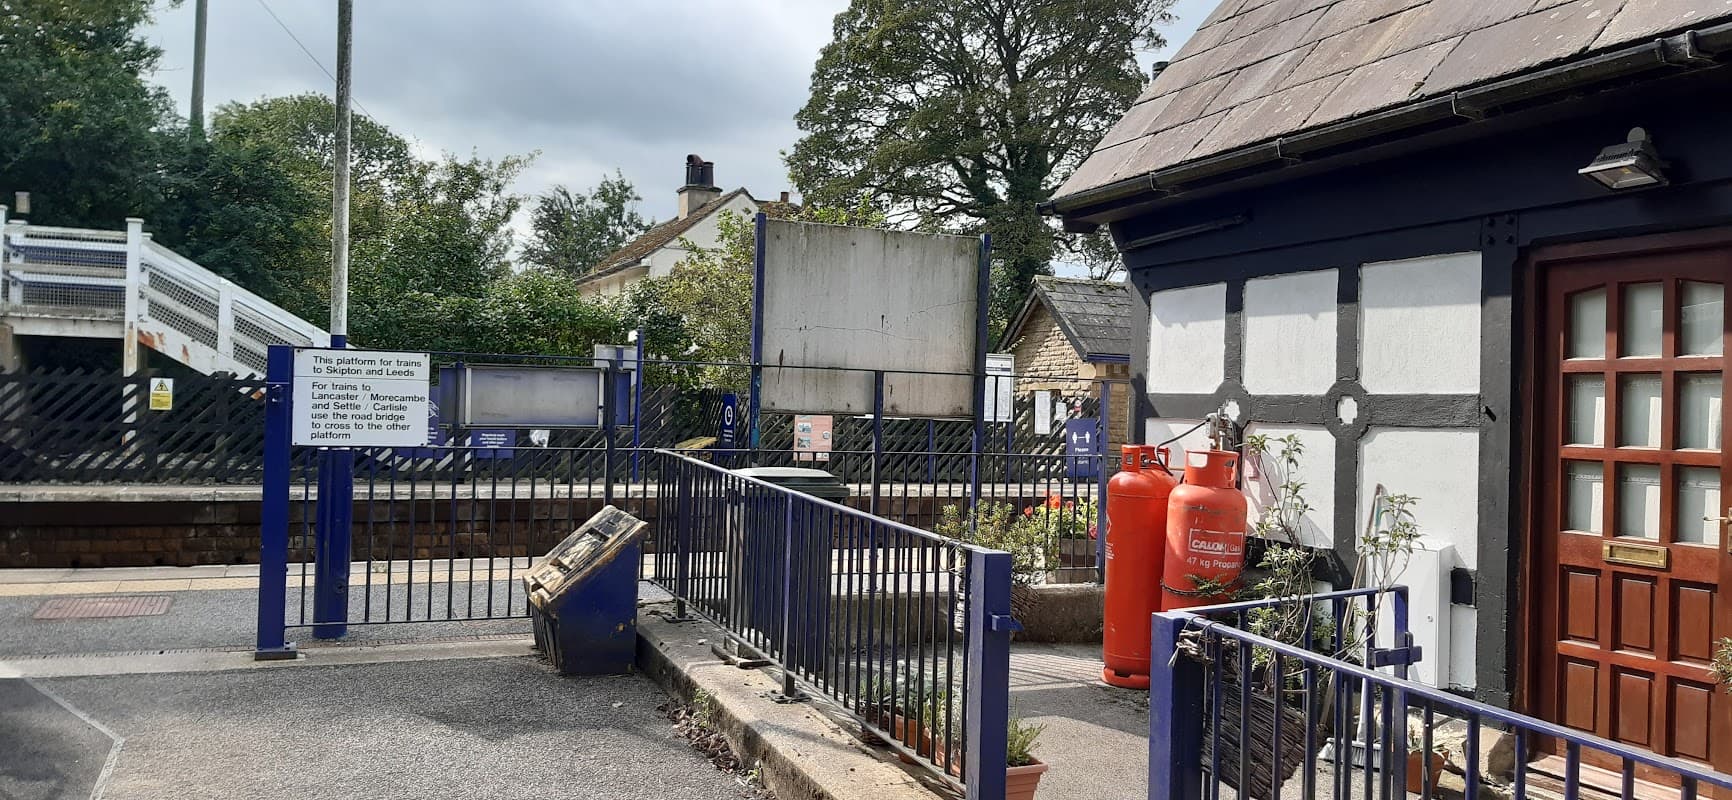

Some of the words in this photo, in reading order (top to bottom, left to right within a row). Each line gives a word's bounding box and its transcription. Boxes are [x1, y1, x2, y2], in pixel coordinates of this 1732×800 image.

[313, 356, 333, 364] This
[336, 357, 376, 366] platform
[380, 358, 392, 366] for
[326, 366, 362, 376] Skipton
[366, 368, 383, 376] and
[386, 368, 415, 376] Leeds
[312, 382, 328, 390] For
[332, 382, 358, 391] trains
[312, 392, 359, 400] Lancaster
[370, 393, 426, 402] Morecambe
[312, 402, 330, 410] and
[333, 402, 361, 410] Settle
[372, 402, 408, 412] Carlisle
[332, 412, 348, 420] the
[352, 412, 372, 420] road
[376, 413, 406, 422] bridge
[312, 422, 321, 430] to
[368, 422, 382, 430] the
[310, 431, 351, 440] platform
[1187, 556, 1198, 565] 47
[1200, 559, 1210, 568] kg
